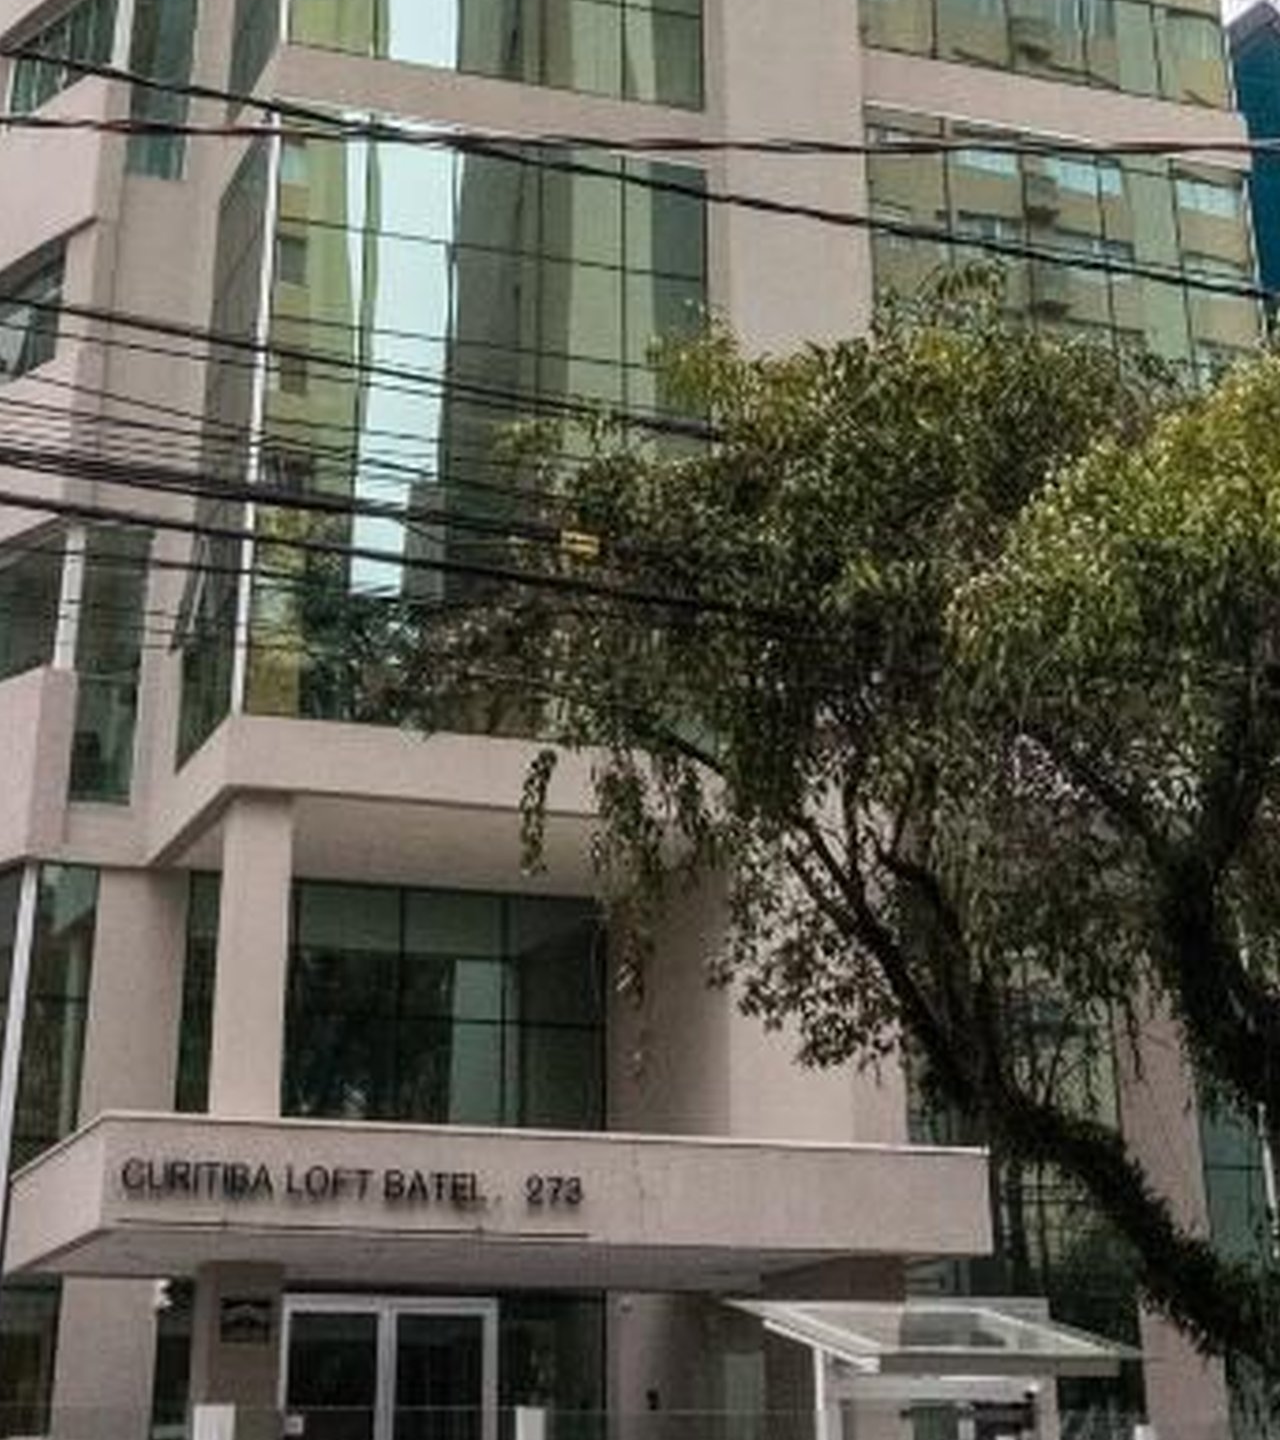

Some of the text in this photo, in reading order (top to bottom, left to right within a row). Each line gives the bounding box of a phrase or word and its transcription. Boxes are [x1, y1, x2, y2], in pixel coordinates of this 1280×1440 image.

[121, 1158, 274, 1200] CURITIBA
[285, 1165, 374, 1202] LOFT
[524, 1174, 584, 1208] 273
